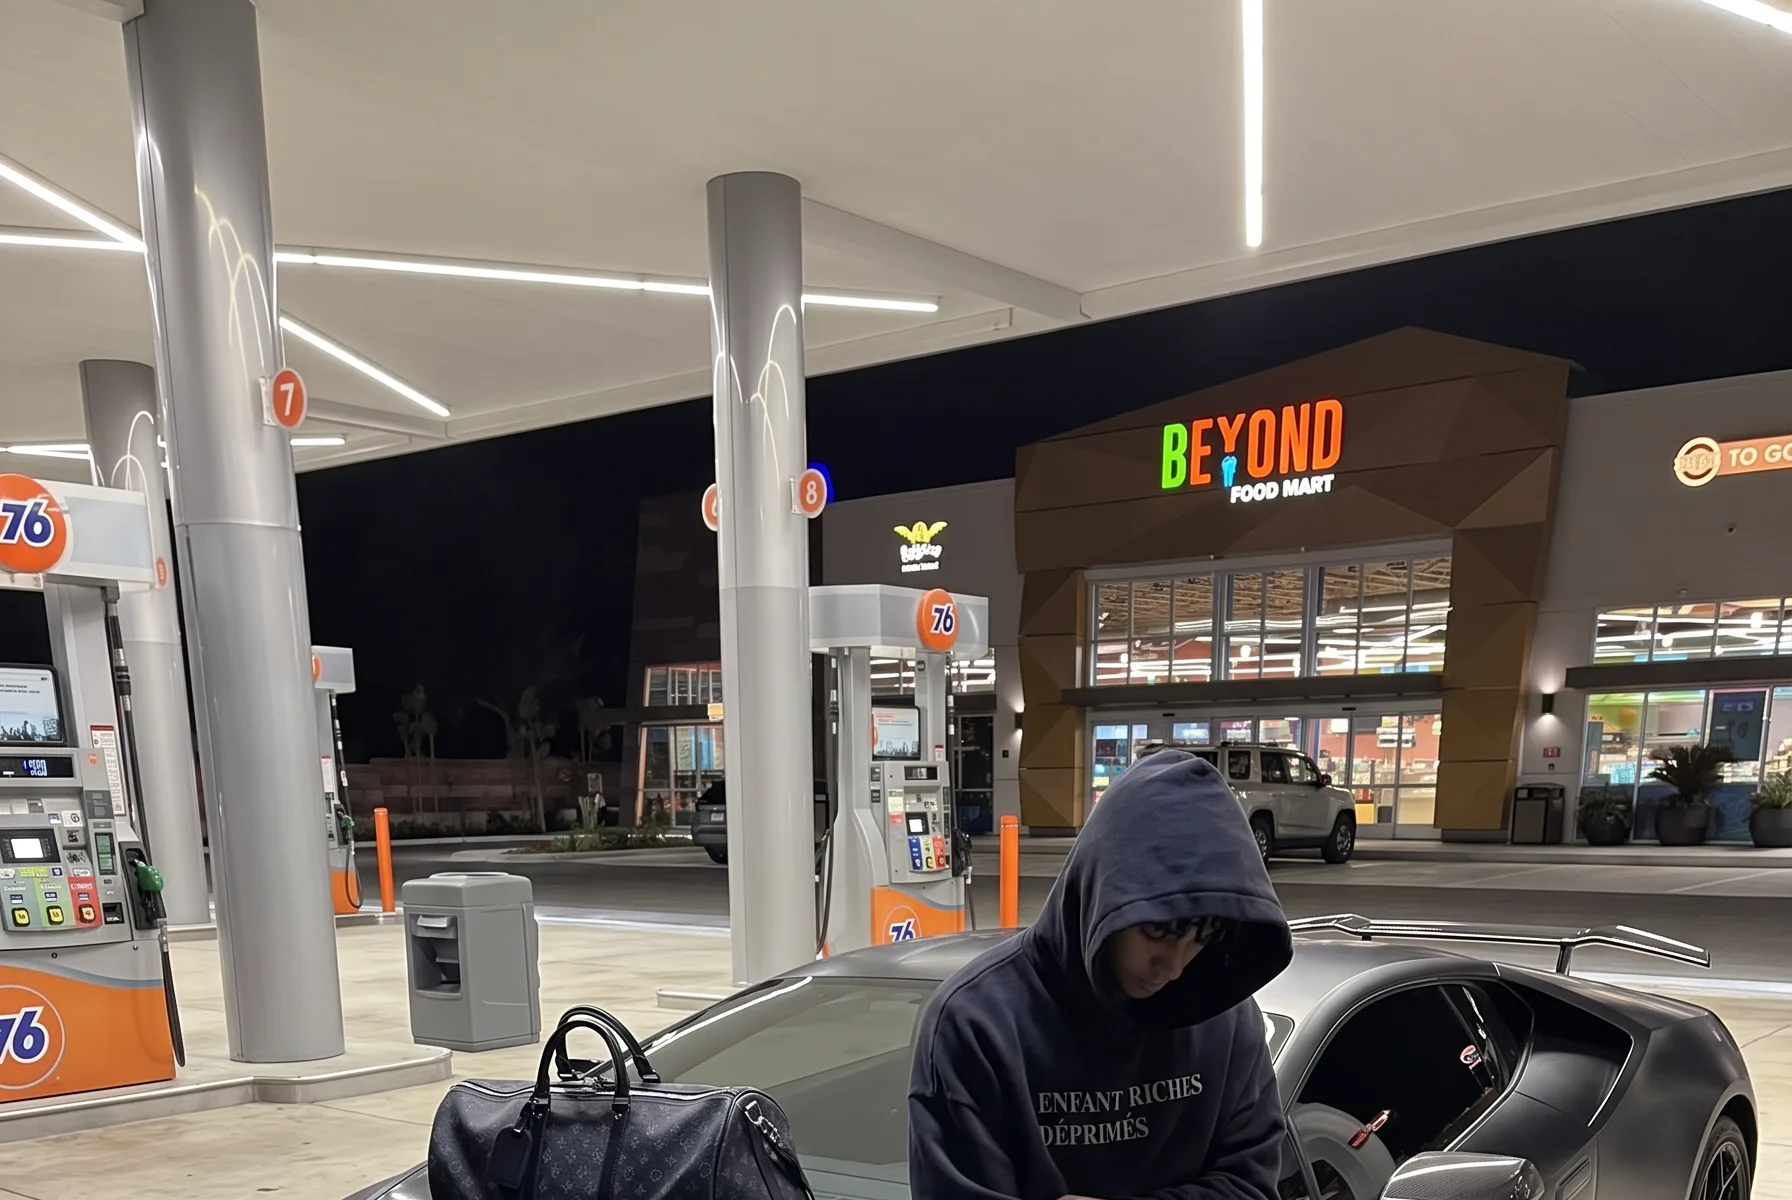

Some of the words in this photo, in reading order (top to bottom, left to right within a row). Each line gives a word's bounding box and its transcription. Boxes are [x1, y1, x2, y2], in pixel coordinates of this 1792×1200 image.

[280, 382, 295, 417] 7
[1161, 398, 1344, 489] BEYOND
[1728, 446, 1758, 468] TO
[805, 480, 818, 505] 8
[1230, 481, 1279, 504] FOOD
[1282, 473, 1335, 497] MART
[0, 498, 55, 548] 76
[930, 602, 955, 636] 76
[1038, 1090, 1124, 1114] ENFANT
[1128, 1073, 1203, 1107] RICHES
[1039, 1112, 1150, 1146] DÉPRIMÉS
